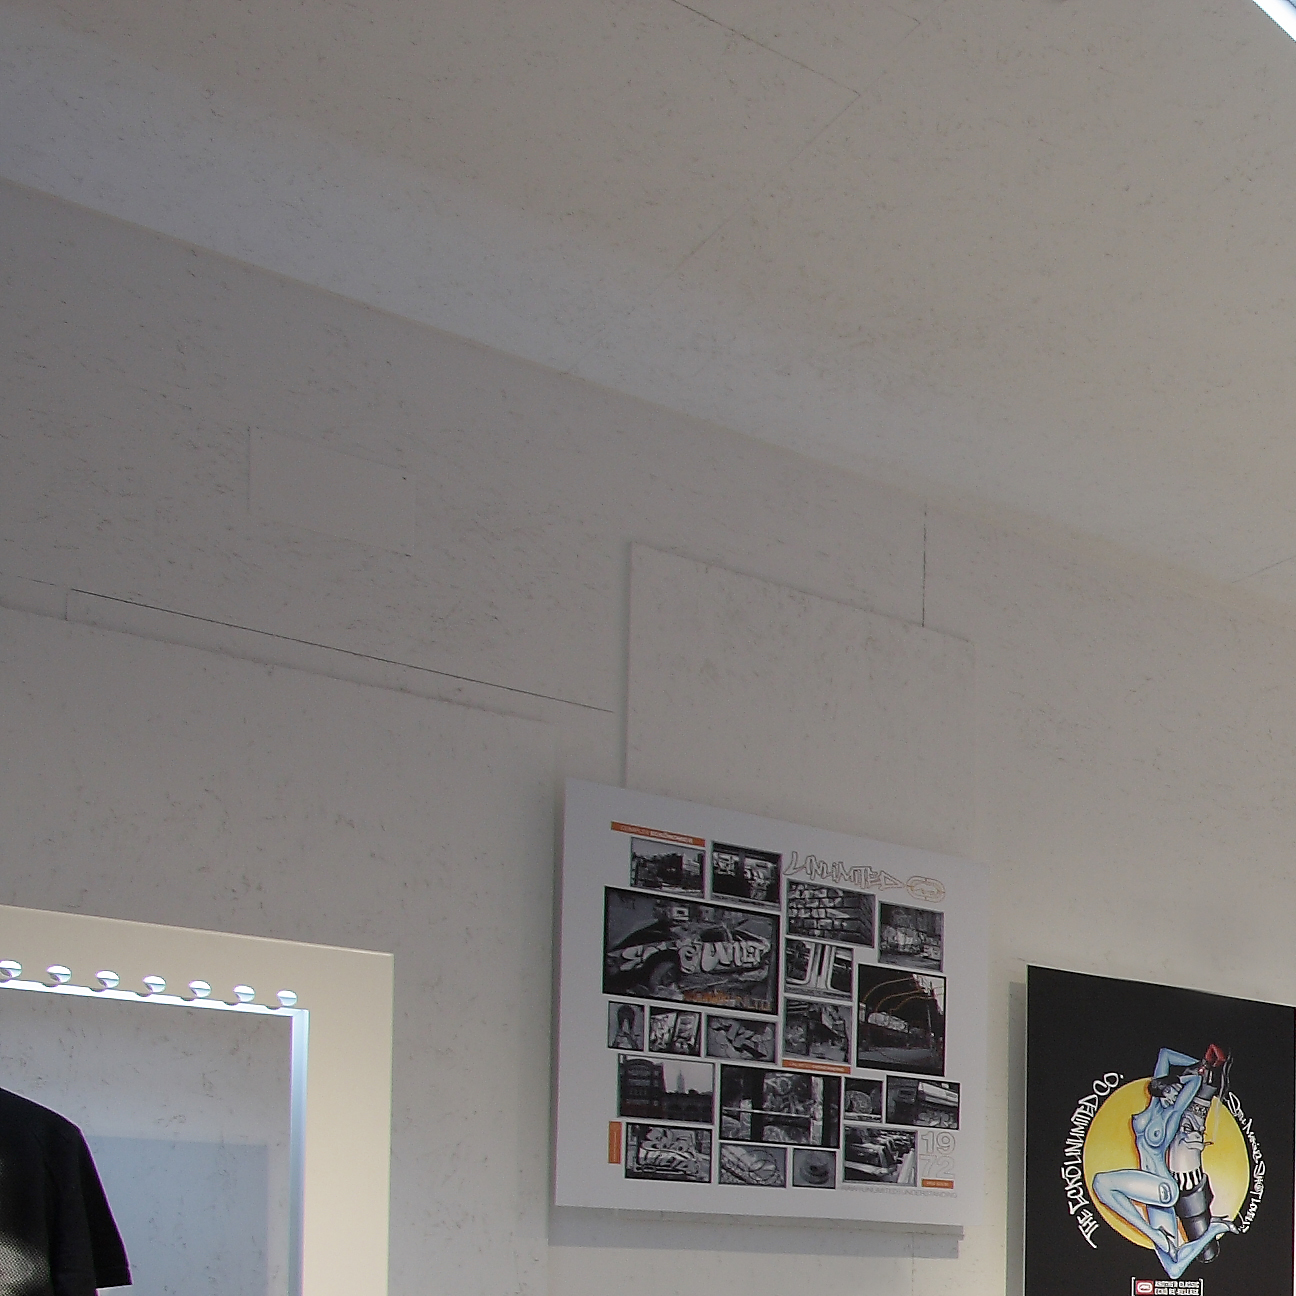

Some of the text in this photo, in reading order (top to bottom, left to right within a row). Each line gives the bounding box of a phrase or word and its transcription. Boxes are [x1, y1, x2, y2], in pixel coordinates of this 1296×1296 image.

[920, 1131, 956, 1155] 19
[1063, 1093, 1100, 1166] UNLIMITED
[1077, 1208, 1101, 1249] THE
